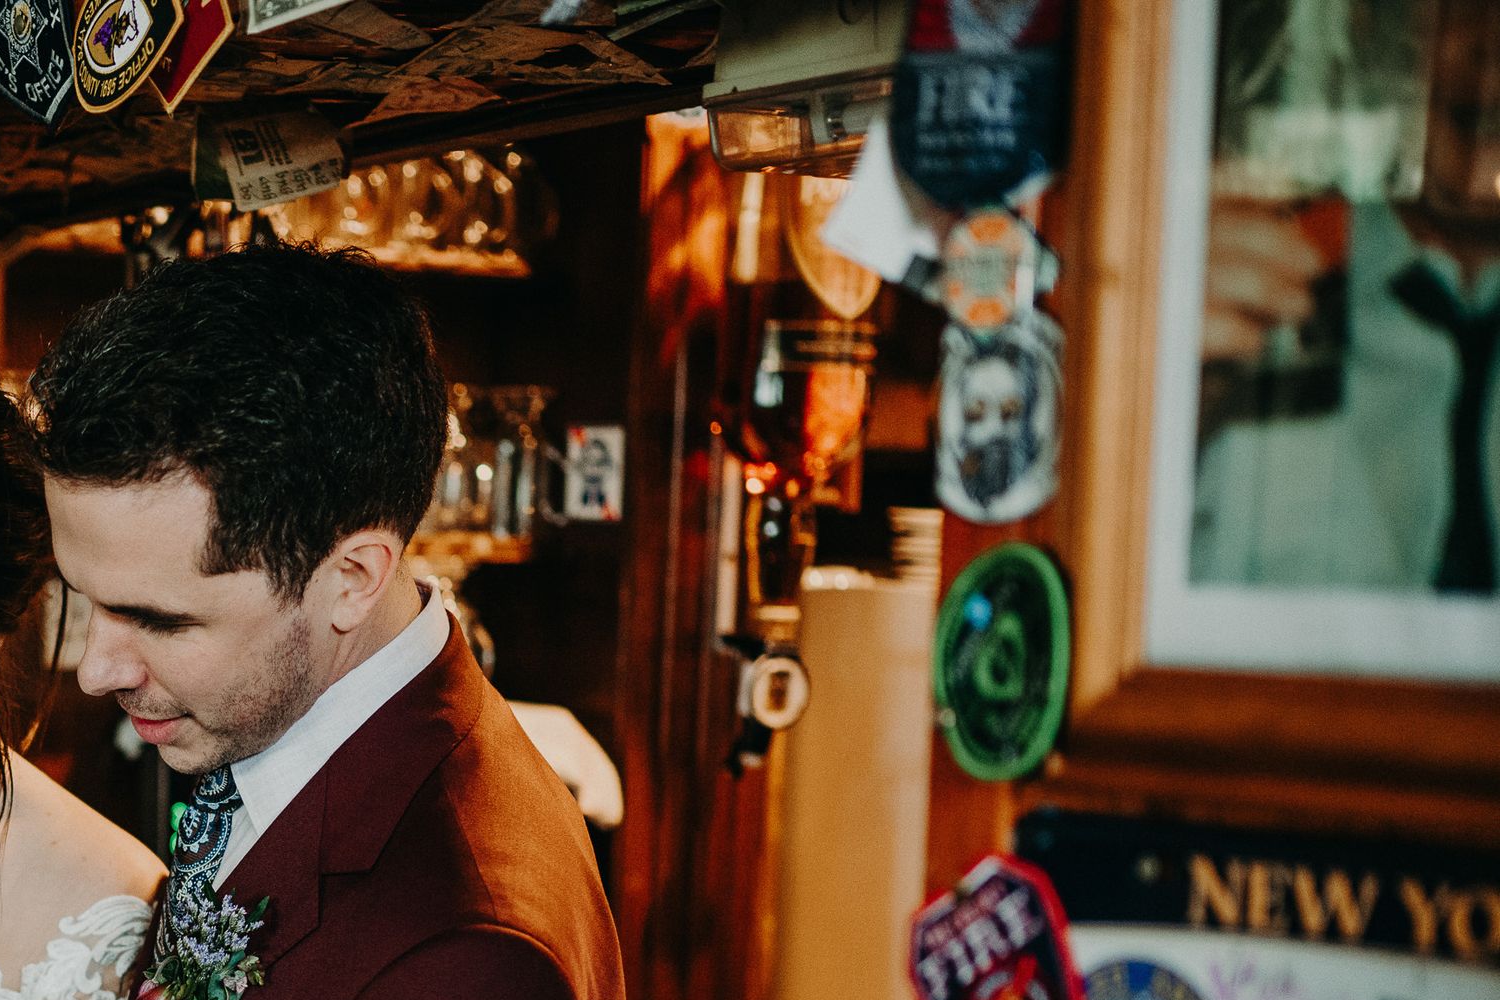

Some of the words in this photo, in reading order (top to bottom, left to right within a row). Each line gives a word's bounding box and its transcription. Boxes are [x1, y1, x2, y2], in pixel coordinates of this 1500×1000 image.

[25, 48, 64, 102] OFFICE
[1188, 853, 1381, 945] NEW
[1400, 874, 1500, 958] YO
